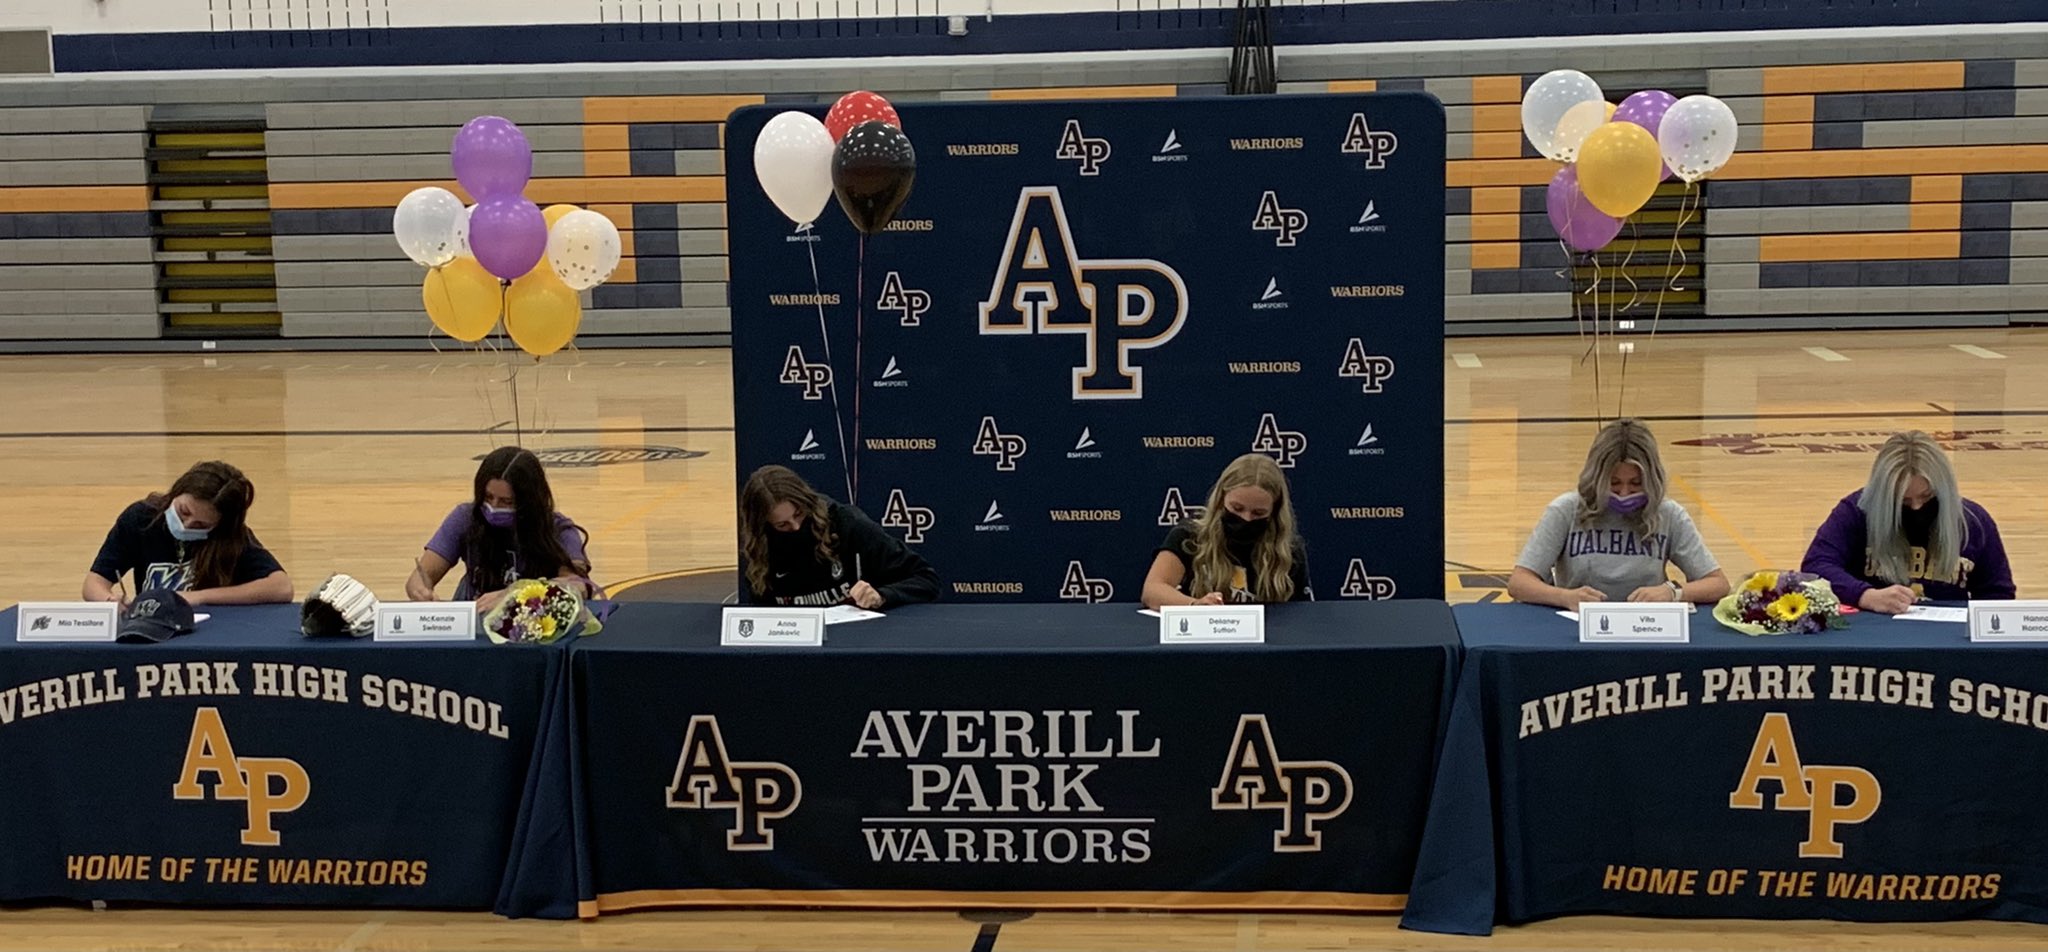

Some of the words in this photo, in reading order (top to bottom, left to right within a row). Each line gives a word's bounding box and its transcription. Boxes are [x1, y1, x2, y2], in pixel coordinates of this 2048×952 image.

[947, 143, 1019, 156] WARRIORS
[1057, 120, 1111, 176] AP
[1230, 137, 1304, 150] WARRIORS
[1341, 112, 1398, 169] AP
[1252, 191, 1308, 247] AP
[769, 294, 840, 305] WARRIORS
[877, 271, 931, 327] AP
[978, 186, 1189, 400] AP
[1330, 285, 1404, 298] WARRIORS
[780, 345, 832, 400] AP
[1228, 362, 1301, 374] WARRIORS
[1339, 338, 1394, 393] AP
[865, 438, 936, 450] WARRIORS
[973, 416, 1026, 471] AP
[1143, 436, 1214, 448] WARRIORS
[1252, 413, 1307, 468] AP
[882, 489, 935, 543] AP
[1050, 510, 1121, 521] WARRIORS
[1331, 507, 1404, 519] WARRIORS
[1569, 529, 1667, 560] UALBANY
[953, 582, 1023, 594] WARRIORS
[1209, 617, 1240, 626] Delaney
[1632, 625, 1663, 633] Spence
[136, 662, 241, 699] PARK
[252, 663, 349, 703] HIGH
[362, 674, 510, 739] SCHOOL
[1518, 672, 1688, 739] AVERILL
[1701, 665, 1816, 703] PARK
[1829, 665, 1935, 710] HIGH
[850, 710, 1161, 758] AVERILL
[173, 707, 310, 846] AP
[665, 714, 802, 852] AP
[907, 764, 1105, 813] PARK
[1211, 713, 1354, 853] AP
[1729, 712, 1881, 858] AP
[862, 827, 1152, 865] WARRIORS
[67, 854, 151, 881] HOME
[160, 856, 196, 882] OF
[205, 857, 259, 884] THE
[267, 859, 428, 887] WARRIORS
[1602, 864, 1697, 895] HOME
[1706, 869, 1748, 896] OF
[1758, 870, 1817, 898] THE
[1826, 872, 2002, 901] WARRIORS
